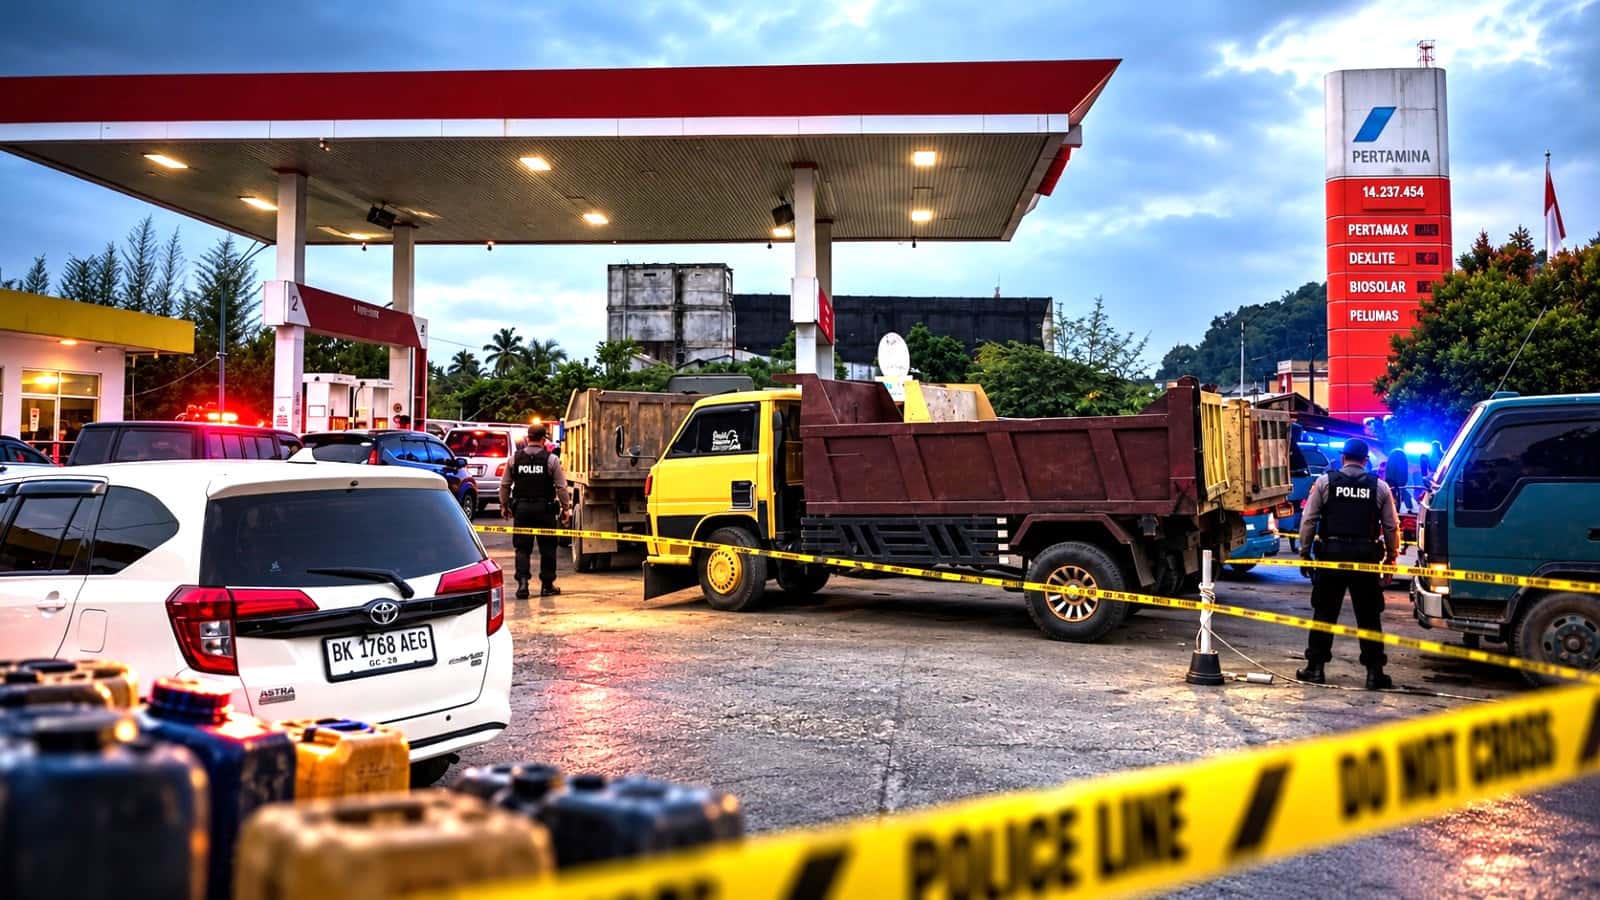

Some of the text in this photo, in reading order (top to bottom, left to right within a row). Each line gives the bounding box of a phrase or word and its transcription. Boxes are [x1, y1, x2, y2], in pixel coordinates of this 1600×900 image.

[1352, 150, 1430, 163] PERTAMINA
[1362, 186, 1424, 198] 14.237.454
[1348, 224, 1408, 236] PERTAMAX
[1349, 252, 1395, 264] DEXLITE
[1350, 281, 1406, 293] BIOSOLAR
[291, 295, 298, 312] 2
[1350, 310, 1399, 321] PELUMAS
[518, 465, 543, 474] POLISI
[1336, 487, 1370, 498] POLISI
[332, 630, 428, 663] BK 1768 AEG
[260, 686, 295, 697] ASTRA
[907, 709, 1557, 900] POLICE LINE DO NOT CROSS
